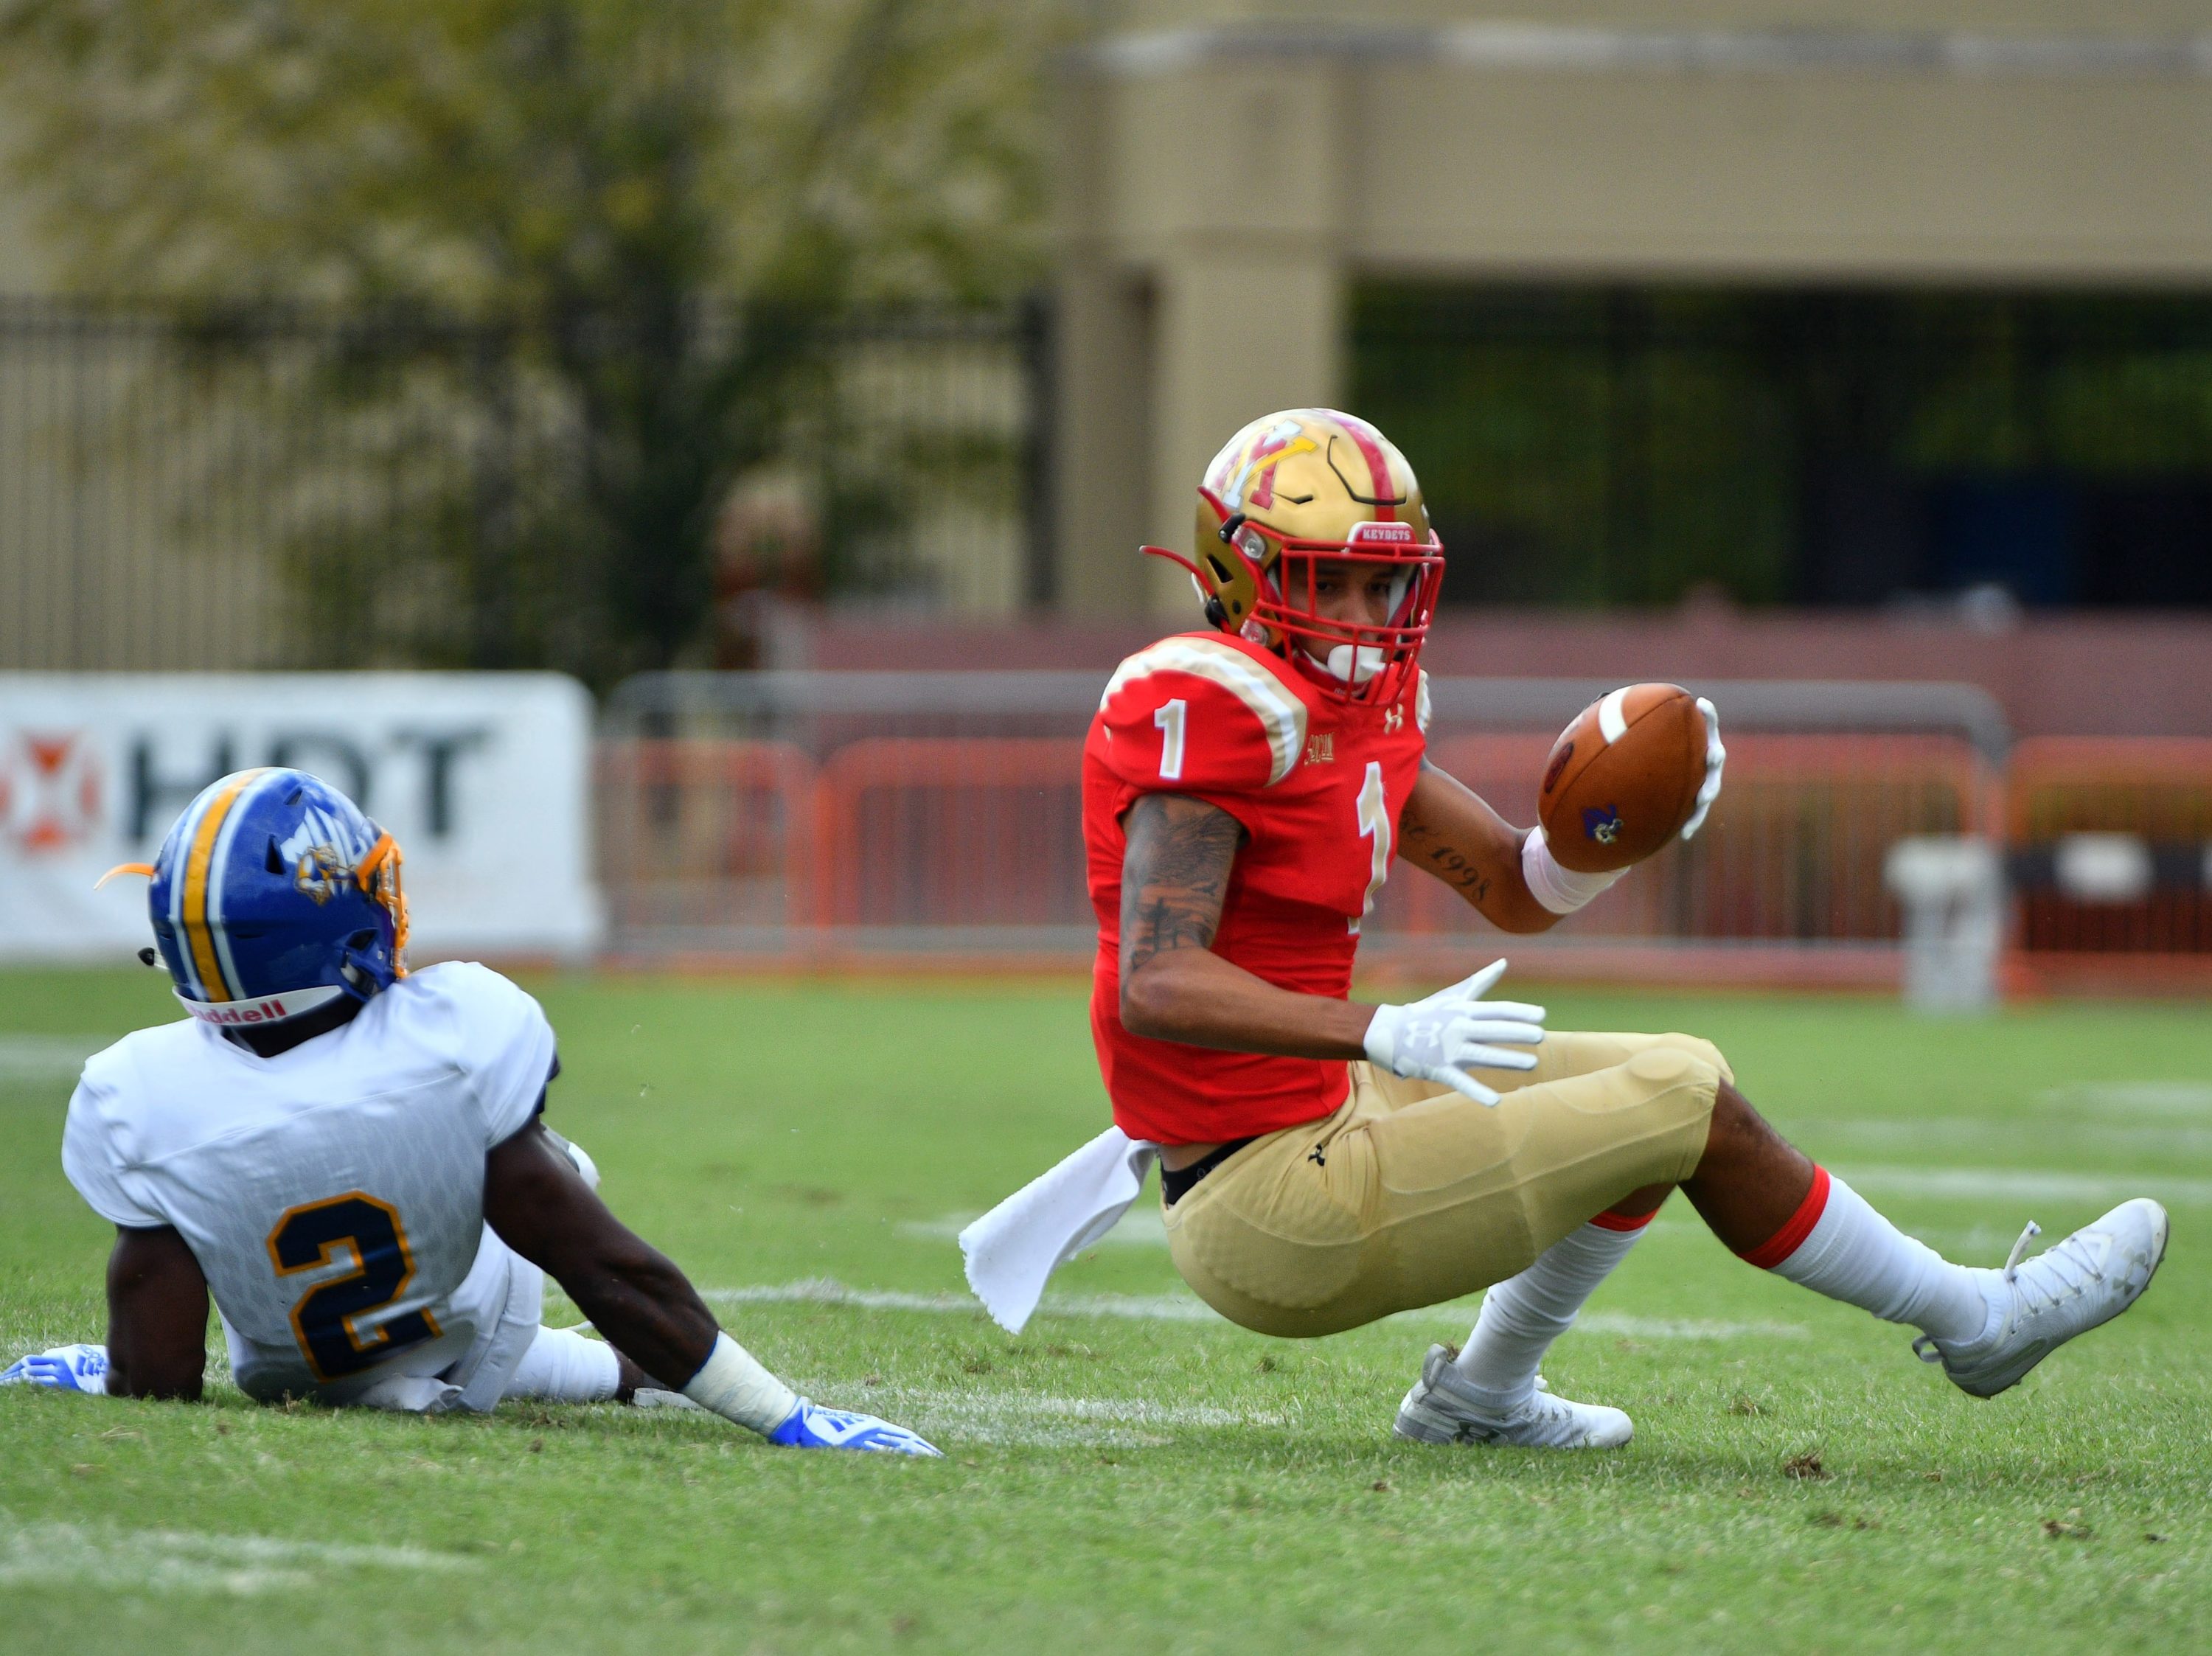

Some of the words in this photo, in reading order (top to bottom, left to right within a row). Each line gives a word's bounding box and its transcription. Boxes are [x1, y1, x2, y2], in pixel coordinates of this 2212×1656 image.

[1363, 528, 1411, 540] KEYDETS
[1154, 697, 1186, 779] 1
[1347, 761, 1391, 935] 1
[265, 1189, 445, 1385] 2
